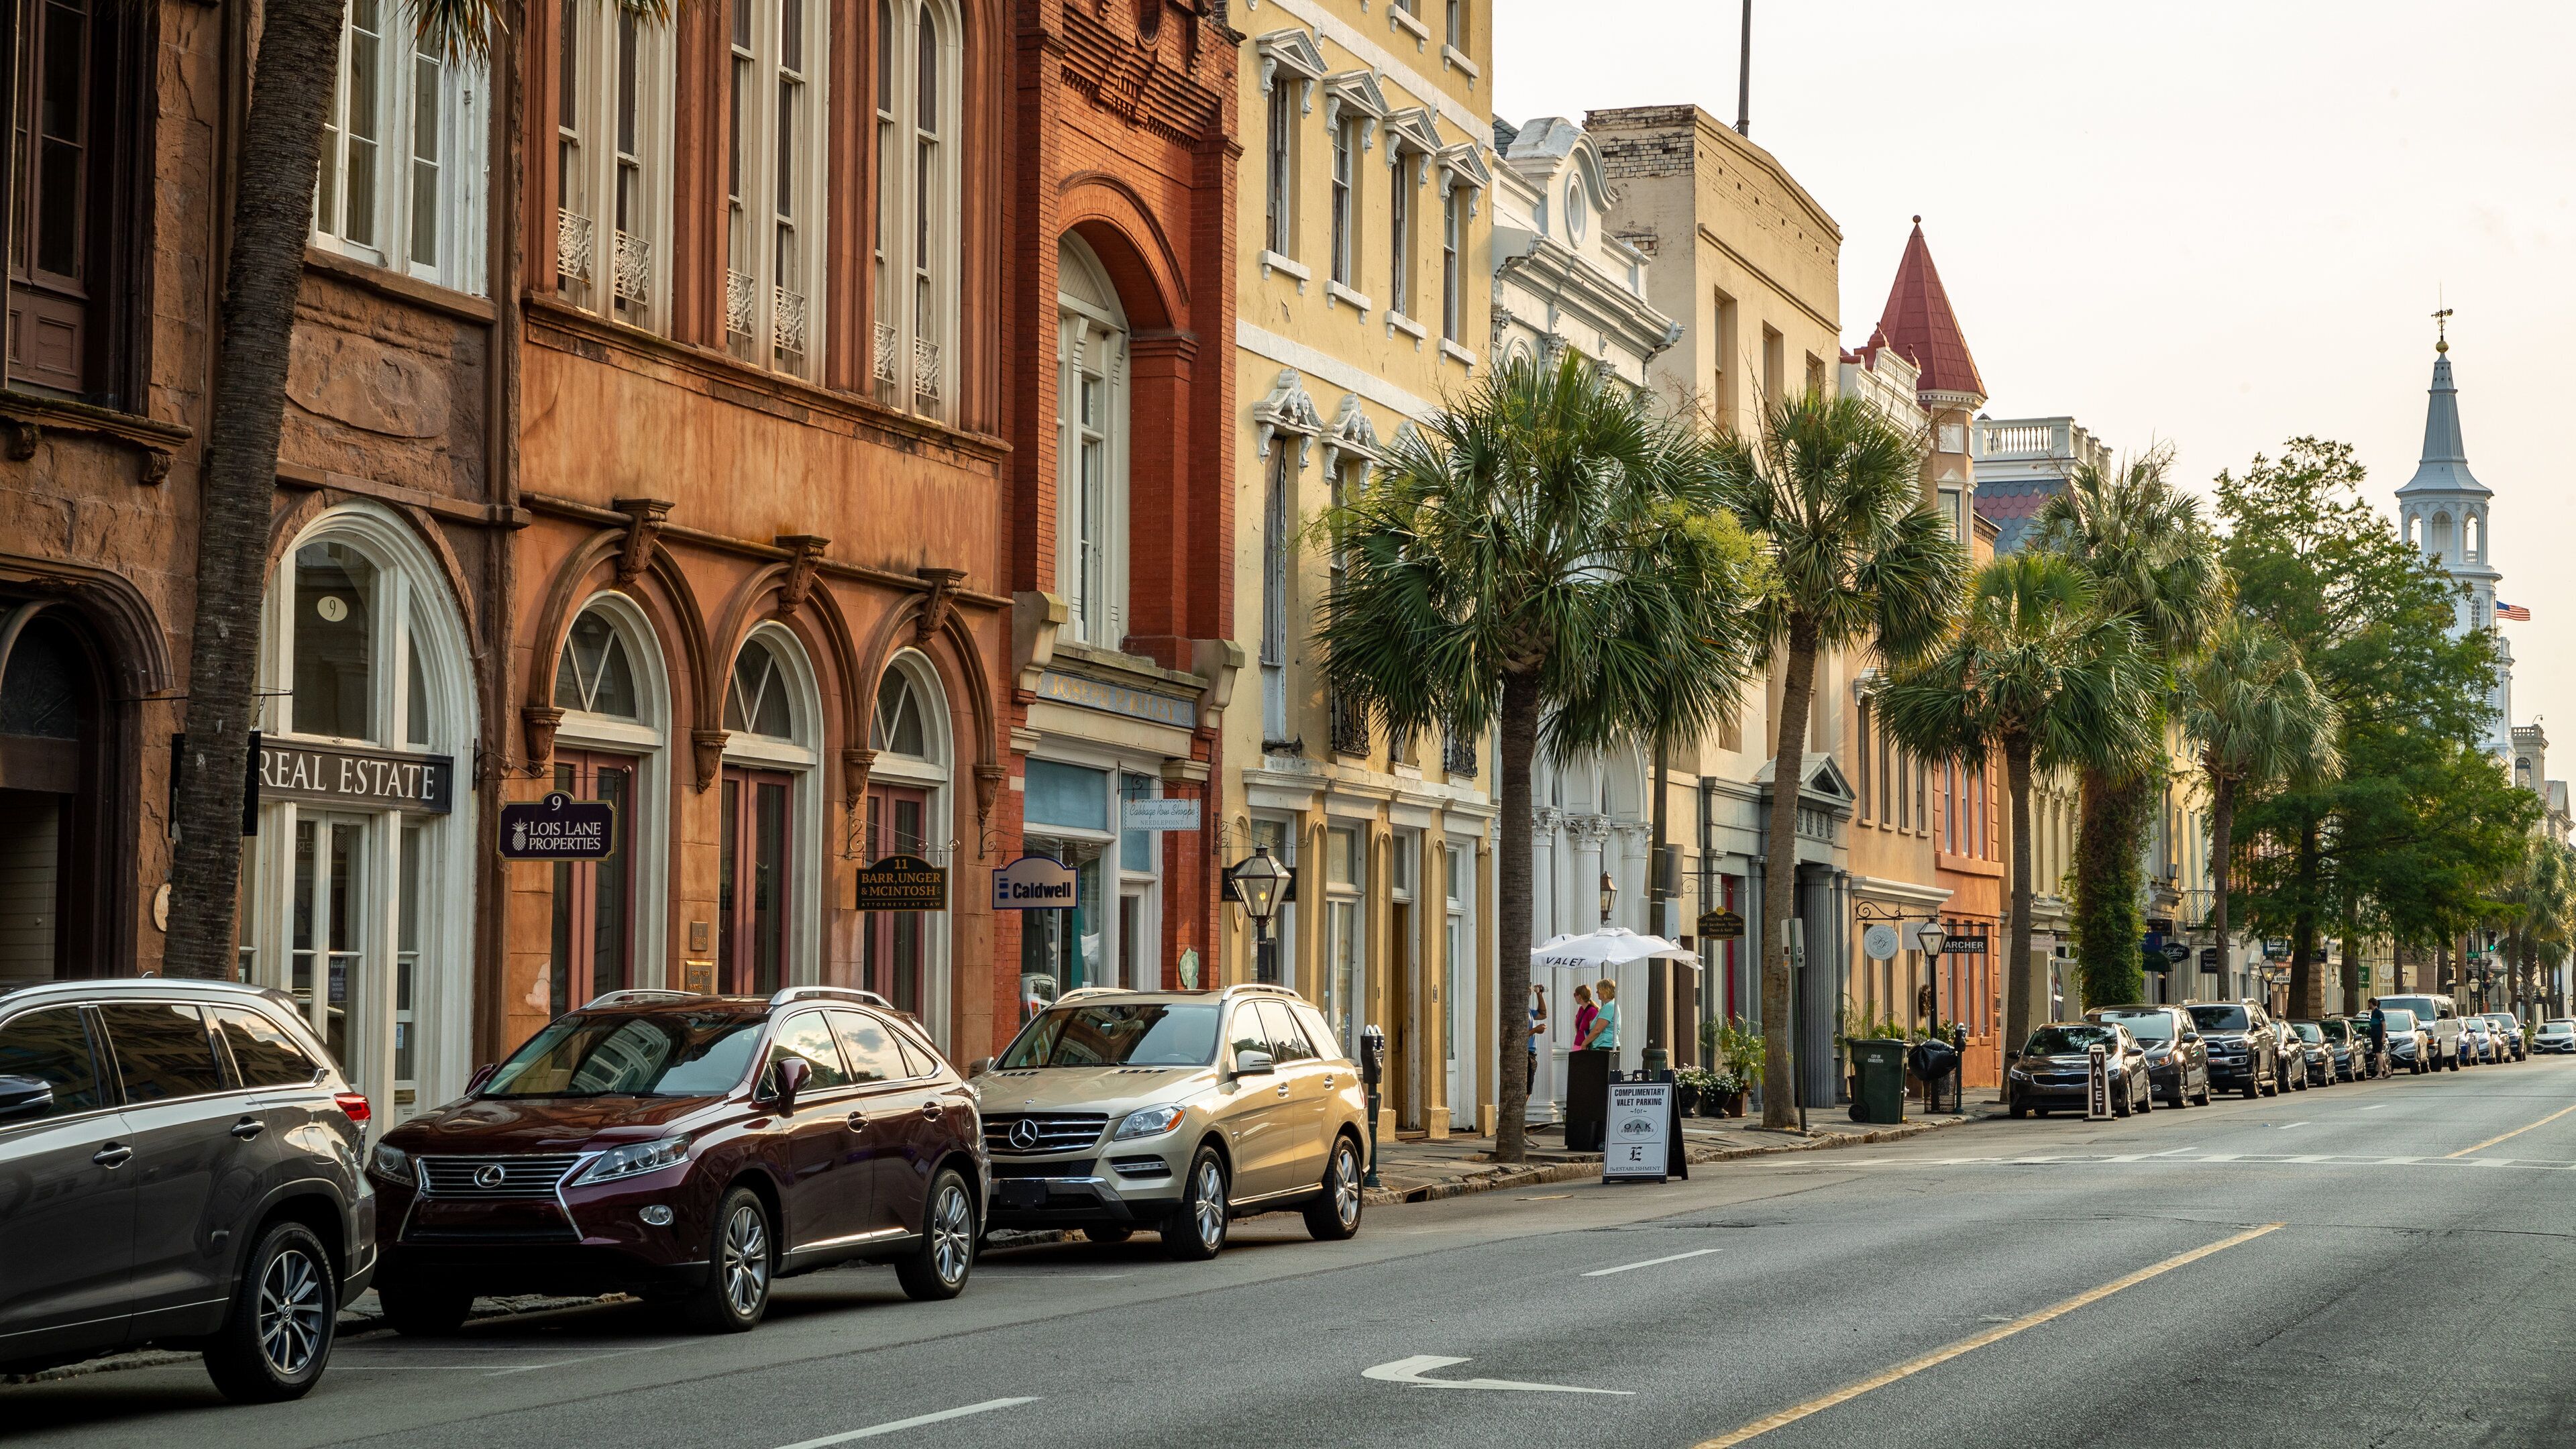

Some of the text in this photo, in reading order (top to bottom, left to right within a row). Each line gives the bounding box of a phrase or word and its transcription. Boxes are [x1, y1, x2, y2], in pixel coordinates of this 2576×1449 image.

[329, 600, 336, 618] 9
[1049, 676, 1111, 706] JOSEPH
[1129, 692, 1177, 720] RILEY
[259, 750, 435, 800] REAL ESTATE
[551, 796, 562, 811] 9
[1129, 804, 1195, 819] Cabbage Row Shoppe
[529, 821, 601, 835] LOIS LANE
[529, 837, 600, 850] PROPERTIES
[895, 859, 908, 869] 11
[1013, 881, 1071, 899] Caldwell
[1546, 957, 1587, 967] VALET
[2093, 1054, 2102, 1113] VALET
[1614, 1088, 1665, 1097] COMPLIMENTARY
[1617, 1098, 1634, 1106] VALET
